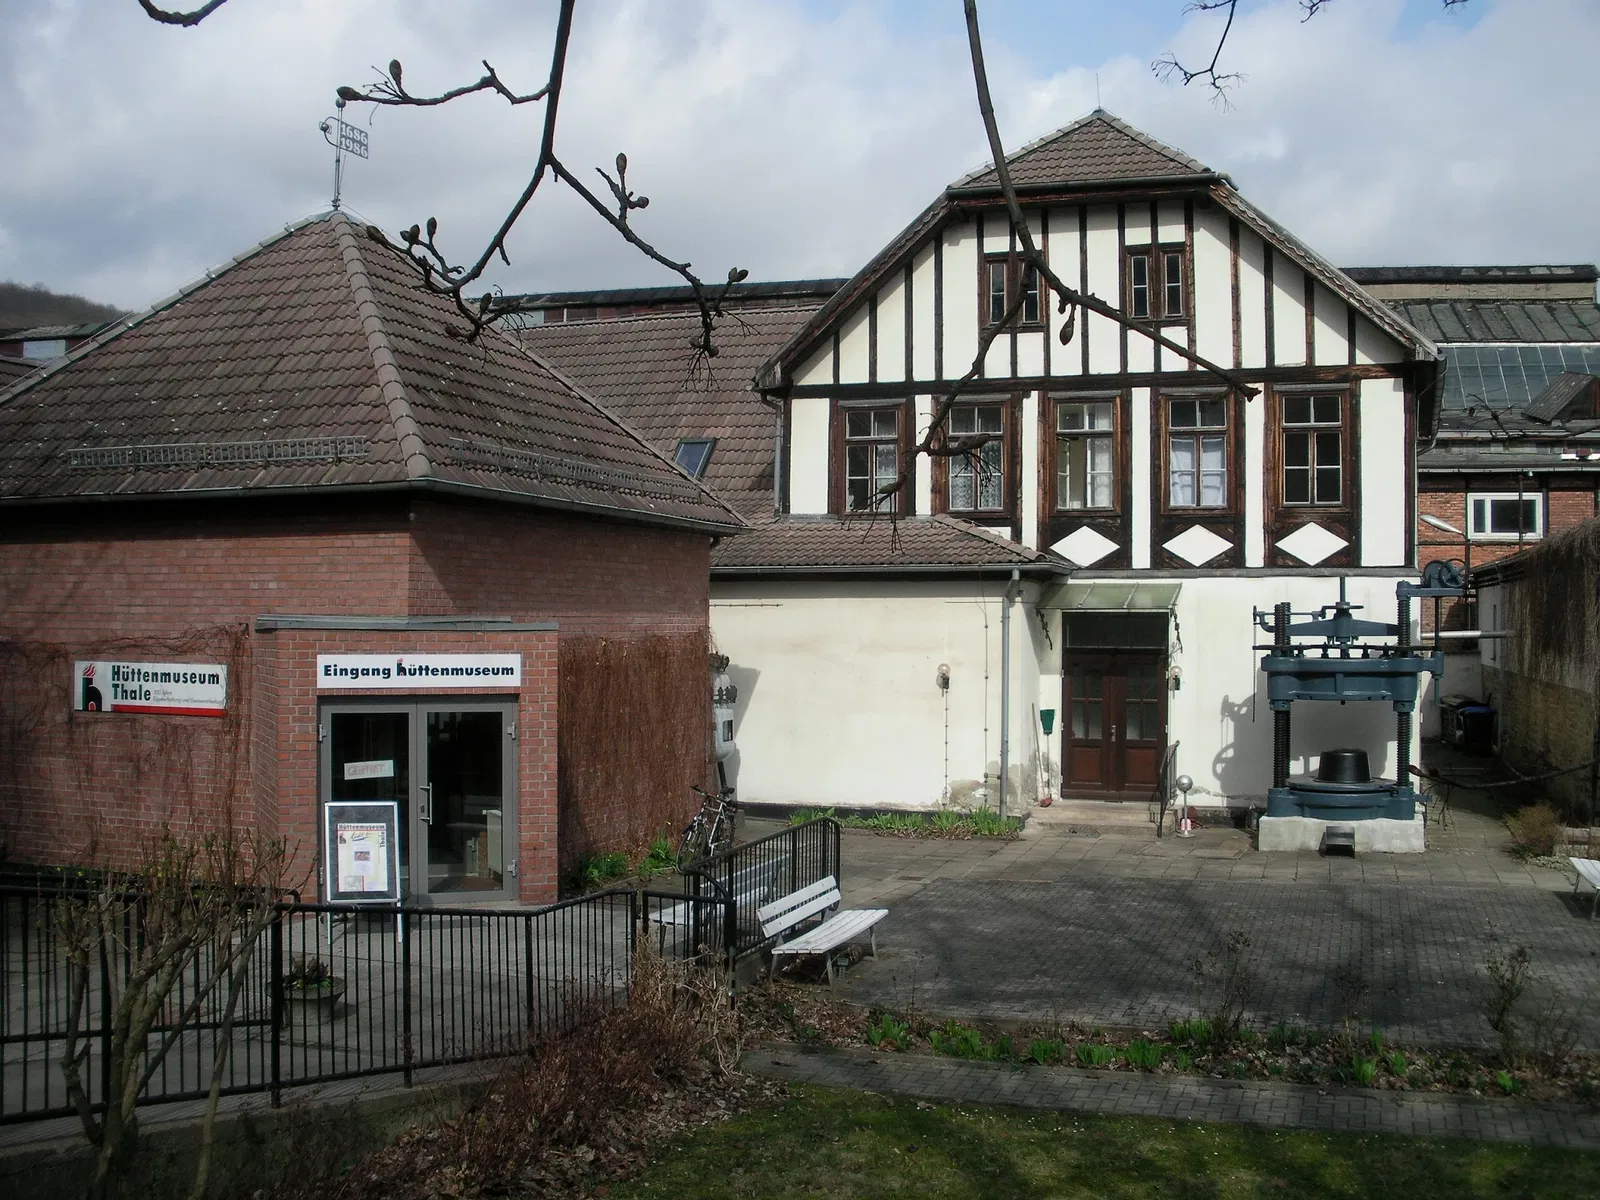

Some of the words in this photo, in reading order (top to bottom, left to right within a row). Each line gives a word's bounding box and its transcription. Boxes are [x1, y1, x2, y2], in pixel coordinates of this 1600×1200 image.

[111, 665, 220, 685] Hüttenmuseum
[323, 664, 391, 679] Eingang
[396, 662, 514, 676] hüttenmuseum
[111, 683, 151, 701] Thale
